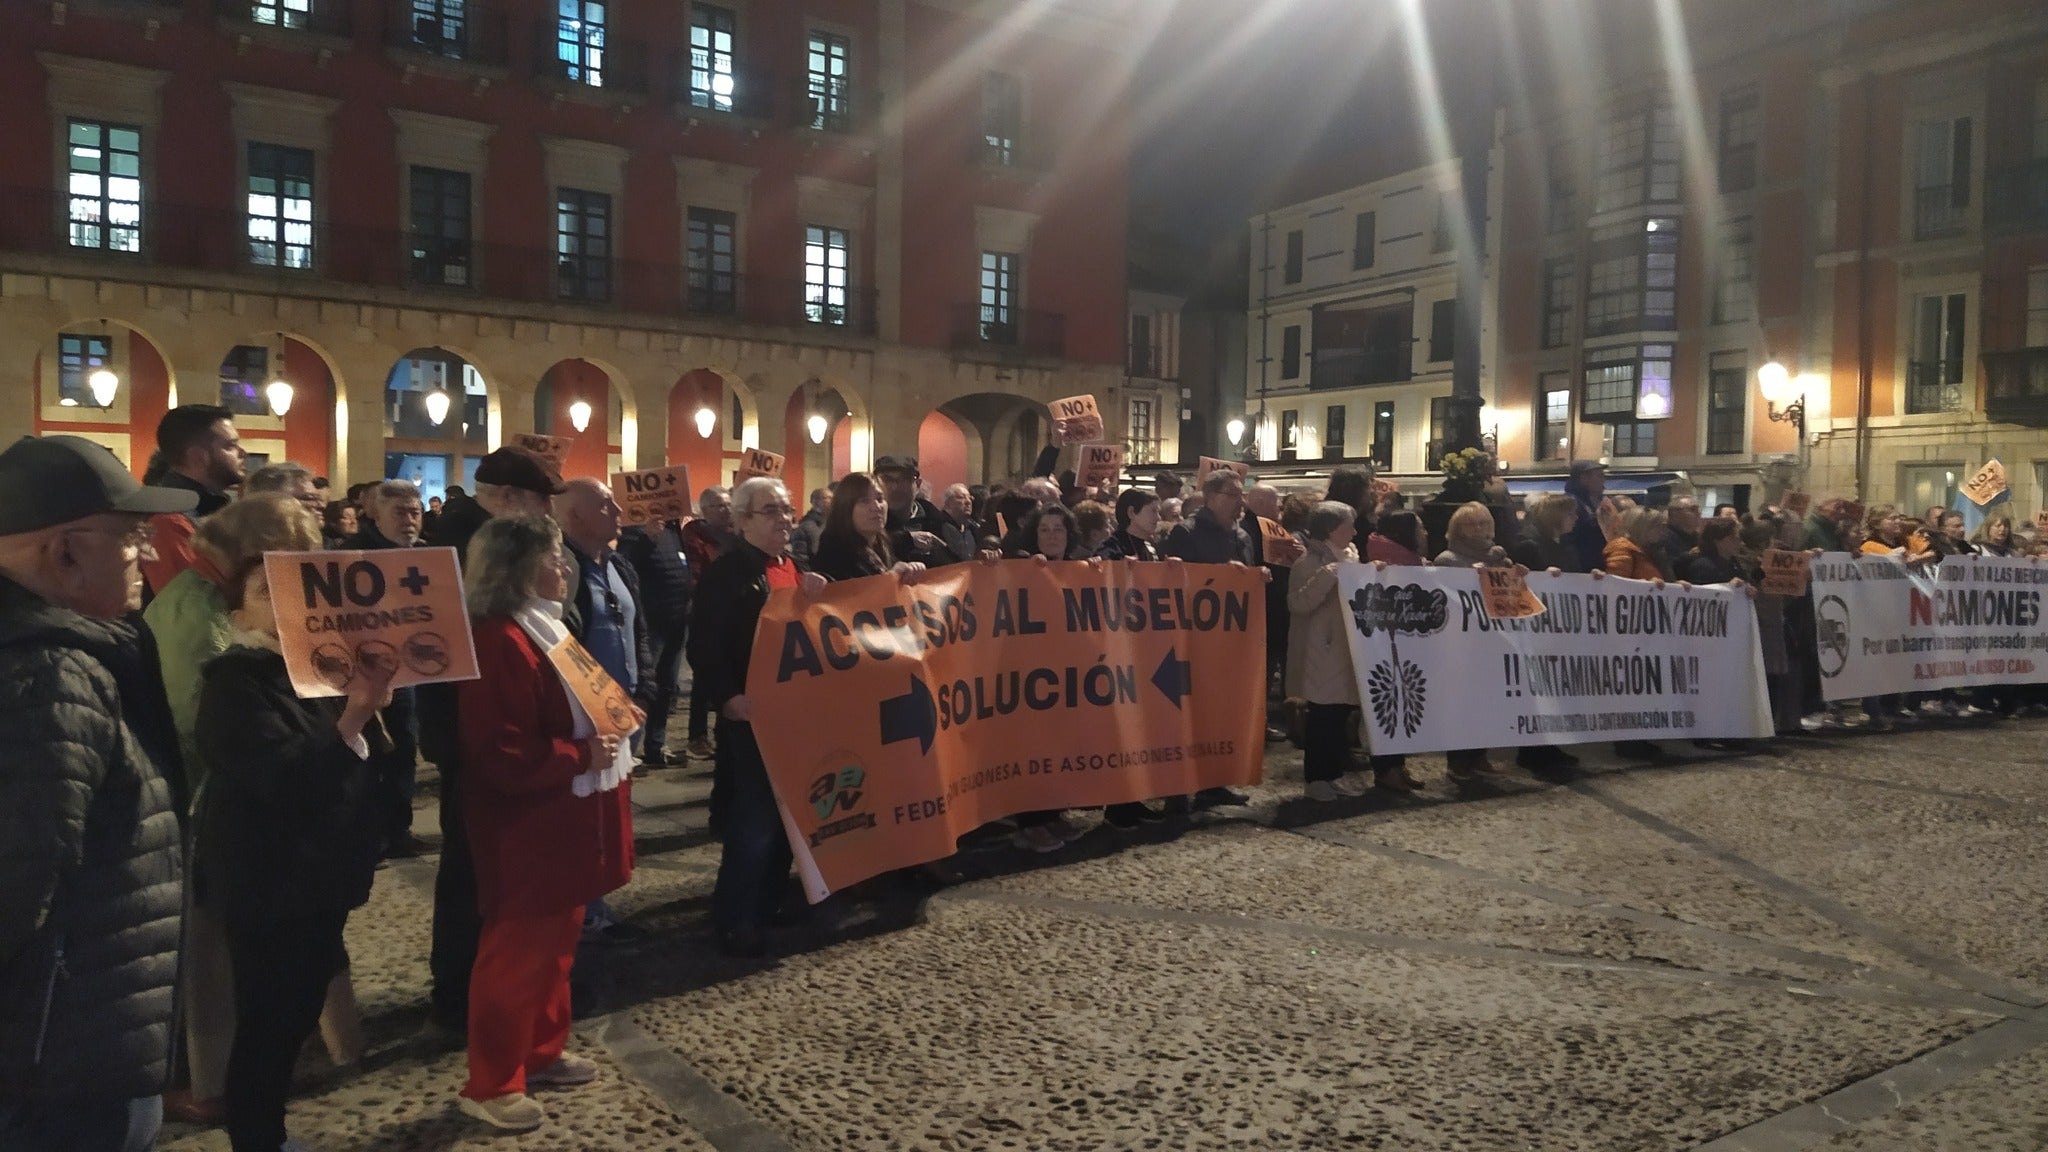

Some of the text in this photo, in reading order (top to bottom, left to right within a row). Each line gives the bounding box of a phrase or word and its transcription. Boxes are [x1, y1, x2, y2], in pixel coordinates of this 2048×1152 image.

[1061, 400, 1084, 416] NO
[751, 452, 773, 472] NO
[1091, 448, 1111, 463] NO
[625, 472, 660, 493] NO
[1968, 473, 1988, 491] NO
[1265, 522, 1285, 537] NO
[299, 560, 386, 609] NO
[305, 605, 433, 634] CAMIONES
[1586, 594, 1608, 634] EN
[777, 578, 1249, 683] ACCESOS AL MUSELÓN
[938, 654, 1137, 732] SOLUCIÓN
[1029, 758, 1053, 775] DE
